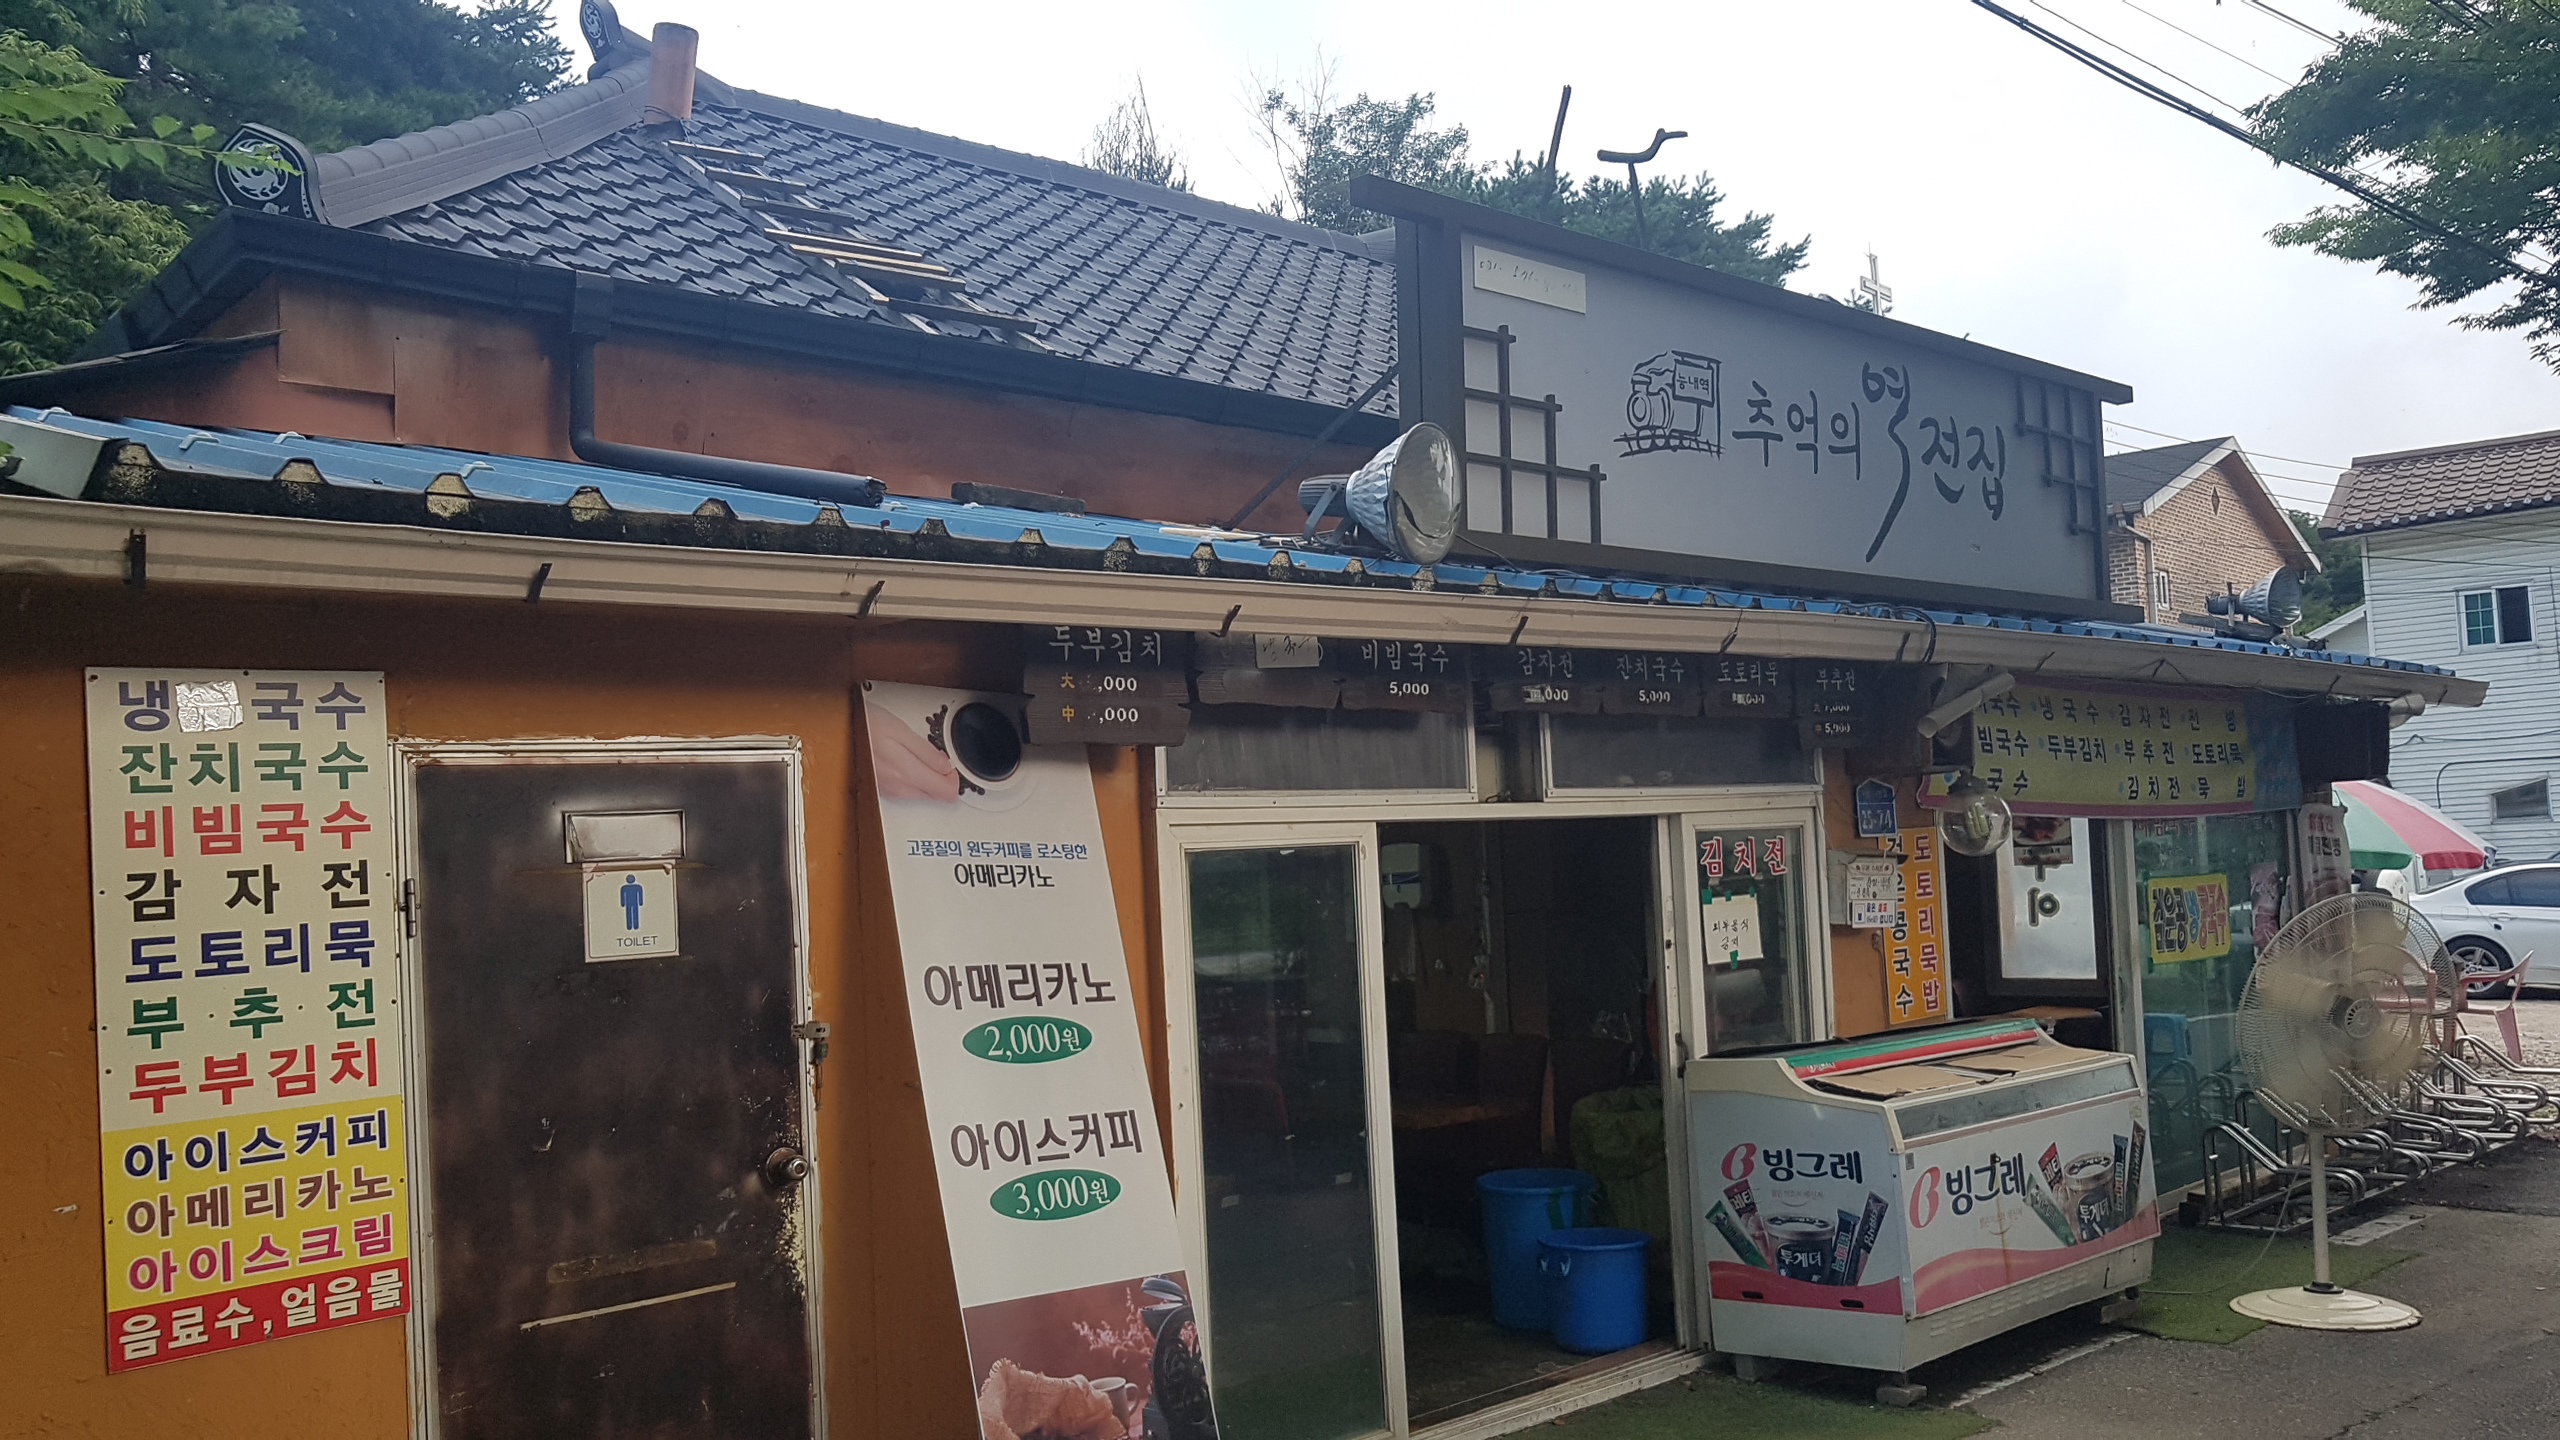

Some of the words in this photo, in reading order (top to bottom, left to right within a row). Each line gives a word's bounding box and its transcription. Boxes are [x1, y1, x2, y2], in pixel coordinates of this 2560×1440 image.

[1676, 372, 1710, 395] 능내역
[1732, 380, 1861, 481] 추억의
[1049, 626, 1161, 666] 두부김치
[1361, 639, 1449, 672] 비빔국수
[1518, 648, 1573, 678] 감자전
[1060, 672, 1075, 689] 大
[1616, 654, 1684, 682] 잔치국수
[1718, 661, 1778, 686] 도토리묵
[1816, 668, 1855, 691] 부추전
[1389, 681, 1429, 696] 5,000
[1639, 690, 1671, 703] 5,000
[1061, 705, 1075, 722] 中
[2038, 695, 2099, 724] 냉국수
[2118, 703, 2171, 729] 감자전
[2047, 735, 2107, 763] 두부김치
[2124, 739, 2175, 764] 부추전
[2192, 742, 2245, 764] 도토리묵
[119, 741, 369, 793] 잔치국수
[2127, 775, 2181, 800] 김치전
[124, 801, 371, 857] 비빔국수
[907, 839, 961, 858] 고품질의
[966, 841, 1032, 859] 원두커피를
[1037, 843, 1088, 860] 로스팅한
[1701, 836, 1787, 877] 김치전
[124, 859, 370, 922] 감자전
[954, 863, 1055, 888] 아메리카노
[1712, 918, 1749, 932] 외부음식
[1914, 834, 1940, 1011] 도토리묵밥
[125, 920, 375, 983] 도토리묵
[617, 936, 658, 947] TOILET
[1721, 936, 1739, 951] 금지
[923, 961, 1116, 1010] 아메리카노
[126, 978, 376, 1049] 부추전
[984, 1022, 1082, 1060] 2,000원
[129, 1037, 378, 1113] 두부김치
[124, 1109, 387, 1181] 아이스커피
[950, 1109, 1143, 1170] 아이스커피
[1763, 1148, 1863, 1185] 빙그레
[1012, 1176, 1111, 1219] 3,000원
[1945, 1152, 2027, 1216] 빙그레
[126, 1167, 393, 1237] 아메리카노
[2079, 1199, 2109, 1224] 투게더
[129, 1214, 392, 1293] 아이스크림
[1780, 1249, 1822, 1269] 투게더
